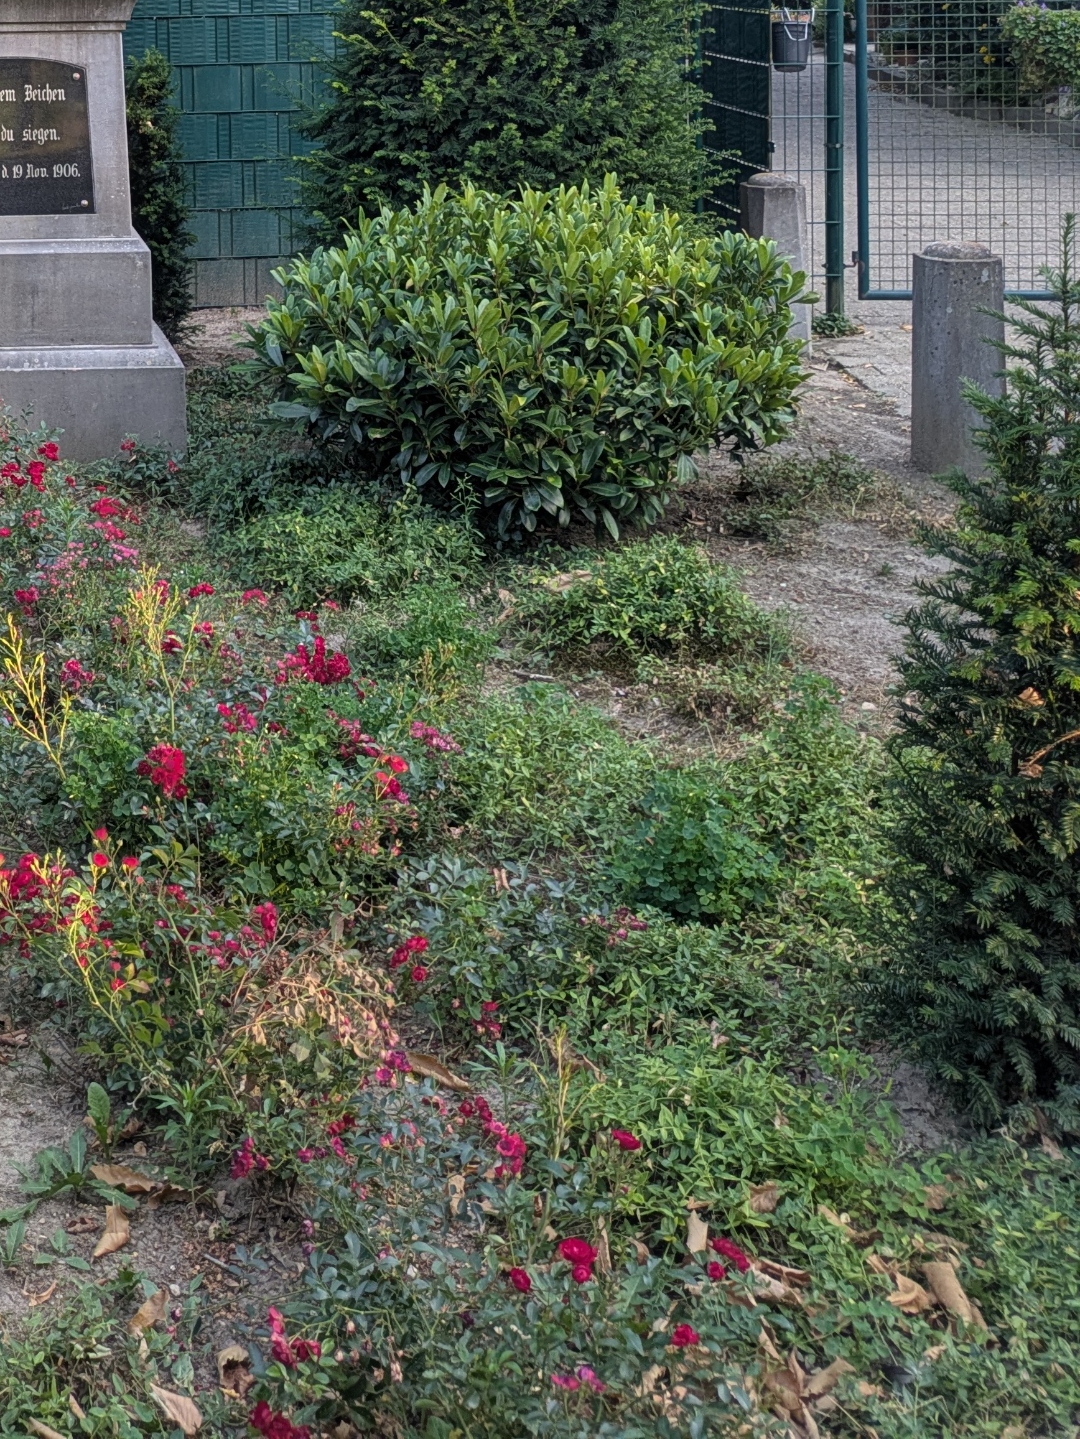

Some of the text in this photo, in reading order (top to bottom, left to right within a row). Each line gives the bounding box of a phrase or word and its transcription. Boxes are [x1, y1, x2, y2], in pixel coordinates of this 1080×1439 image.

[0, 124, 15, 142] du
[21, 124, 61, 145] siegen.
[12, 164, 23, 179] 19
[25, 163, 49, 179] Nov.
[52, 163, 81, 178] 1906.
